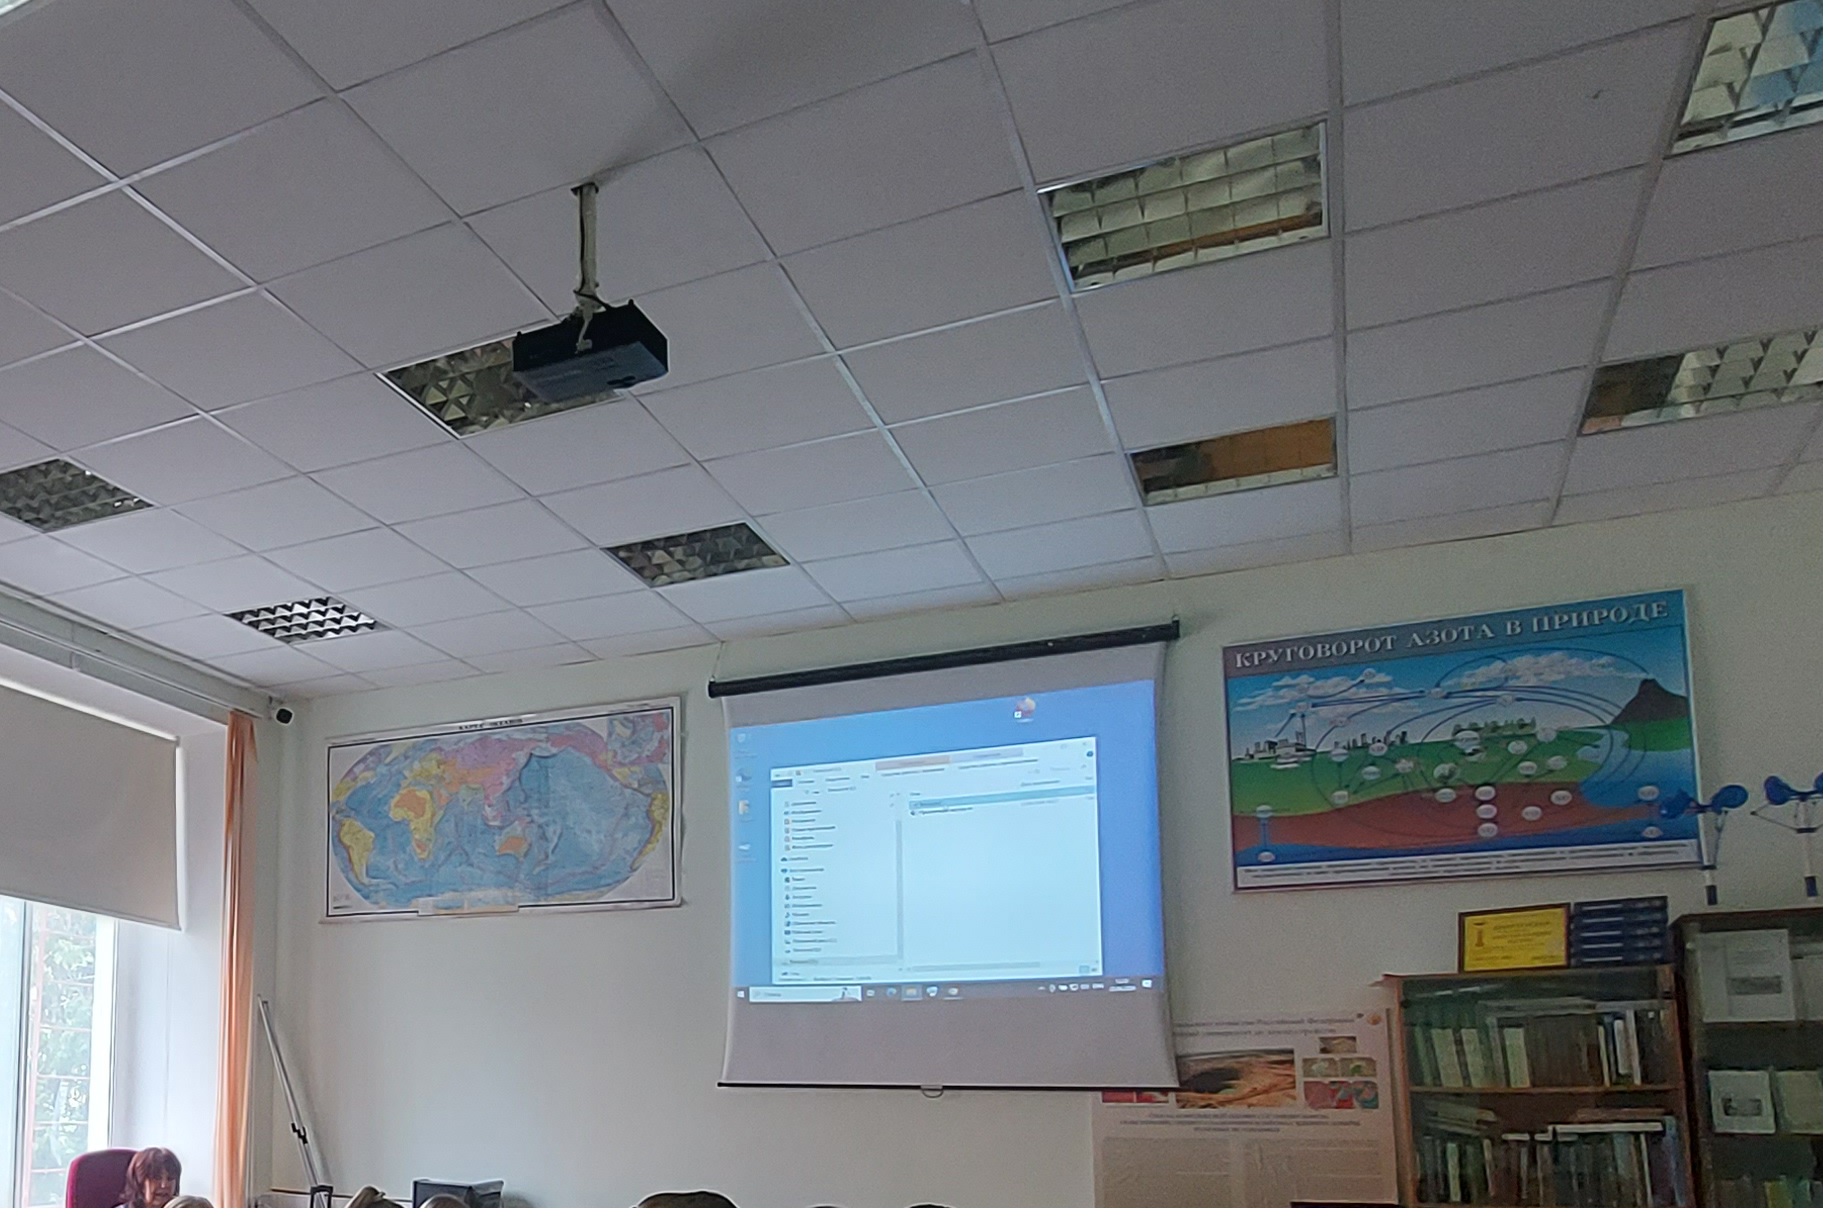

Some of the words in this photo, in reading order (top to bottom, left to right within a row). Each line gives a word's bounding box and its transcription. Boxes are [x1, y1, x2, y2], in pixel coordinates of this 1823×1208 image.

[1235, 635, 1398, 669] КРУГОВОРОТ
[1406, 623, 1495, 648] АЗОТА
[1506, 619, 1523, 636] В
[1532, 601, 1668, 633] ПРИРОДЕ
